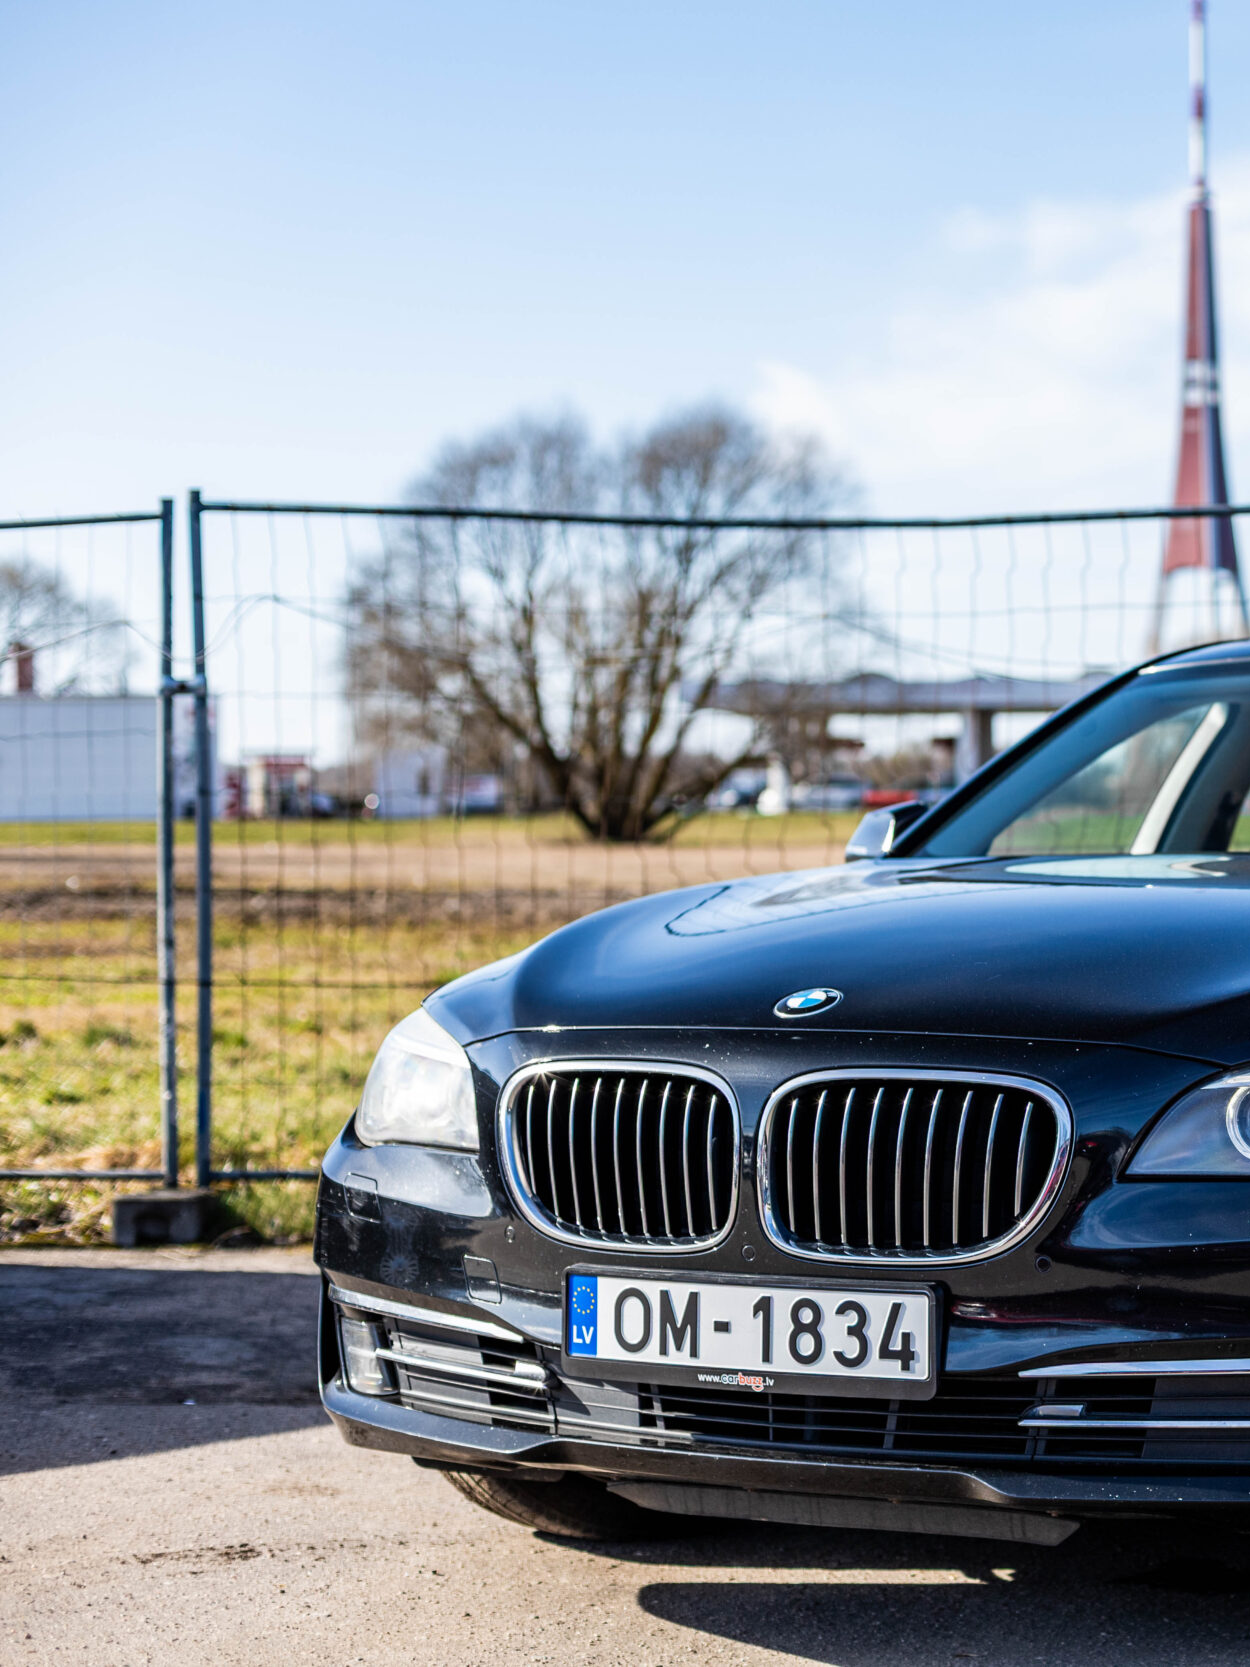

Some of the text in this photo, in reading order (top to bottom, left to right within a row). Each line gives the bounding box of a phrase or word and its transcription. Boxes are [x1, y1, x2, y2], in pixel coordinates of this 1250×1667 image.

[572, 1325, 595, 1345] LV
[614, 1287, 915, 1372] OM-1834
[697, 1372, 775, 1388] www.carbuzz.lv
